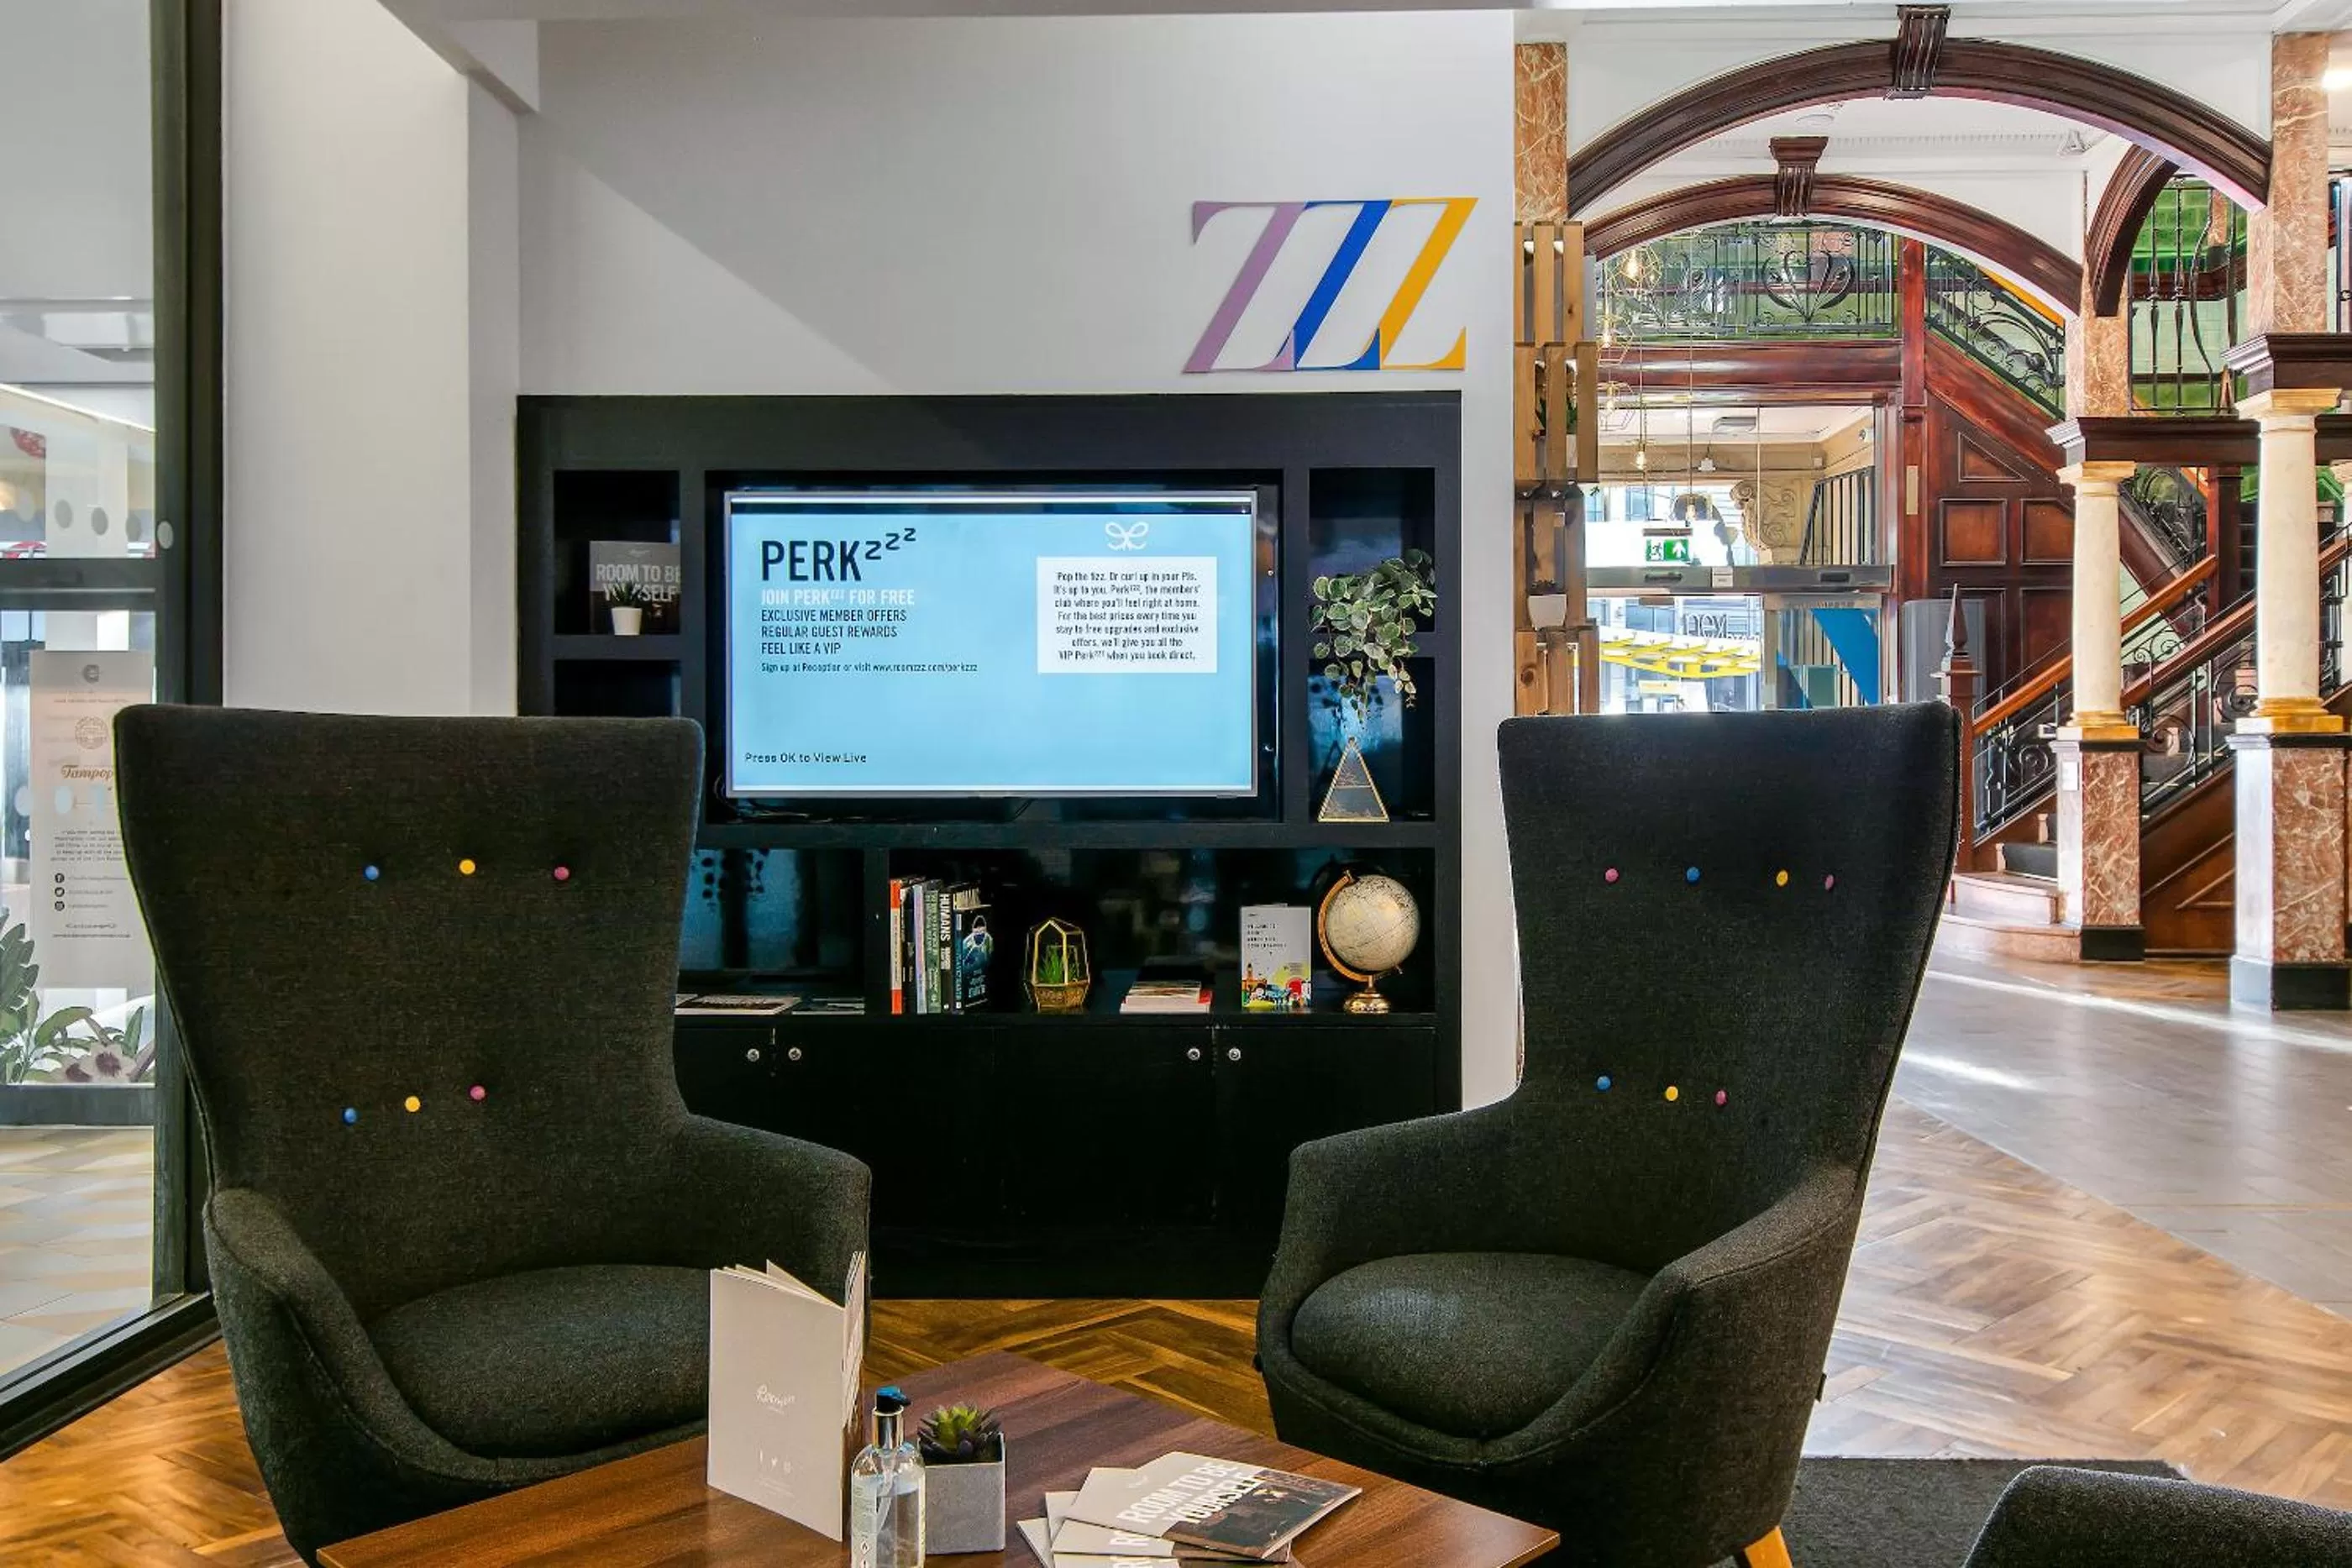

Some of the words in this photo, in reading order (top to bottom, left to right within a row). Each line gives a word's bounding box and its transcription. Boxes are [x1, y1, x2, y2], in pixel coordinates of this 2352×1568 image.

[596, 564, 640, 582] ROOM
[642, 564, 661, 582] TO
[1058, 572, 1073, 583] Pop
[1075, 572, 1088, 581] the
[1121, 572, 1137, 581] curl
[1140, 572, 1148, 583] up
[1152, 572, 1159, 581] in
[1162, 572, 1179, 583] your
[602, 583, 680, 602] YSELF
[1069, 585, 1077, 596] up
[1081, 585, 1089, 594] to
[1146, 585, 1158, 594] the
[762, 589, 790, 605] JOIN
[850, 589, 875, 605] FOR
[881, 589, 915, 605] FREE
[1055, 598, 1071, 607] club
[1074, 598, 1099, 607] where
[1126, 598, 1141, 607] feel
[1143, 598, 1162, 609] right
[1164, 598, 1172, 607] at
[762, 610, 816, 621] EXCLUSIVE
[820, 610, 864, 621] MEMBER
[867, 610, 906, 621] OFFERS
[1058, 611, 1071, 620] For
[1074, 611, 1087, 620] the
[1089, 611, 1105, 620] best
[1162, 611, 1179, 620] time
[1182, 611, 1197, 621] you
[762, 626, 808, 637] REGULAR
[811, 626, 844, 637] GUEST
[848, 626, 898, 637] REWARDS
[1075, 624, 1083, 633] to
[1085, 624, 1101, 633] free
[1144, 624, 1159, 633] and
[1162, 624, 1199, 633] exclusive
[762, 642, 786, 654] FEEL
[790, 642, 811, 654] LIKE
[813, 642, 821, 654] A
[823, 642, 841, 654] VIP
[1122, 637, 1138, 648] give
[1141, 637, 1155, 648] you
[1158, 637, 1167, 647] all
[1169, 637, 1183, 647] the
[1058, 650, 1073, 659] VIP
[1107, 650, 1128, 659] when
[1131, 650, 1145, 662] you
[1147, 650, 1166, 659] book
[762, 663, 779, 673] Sign
[780, 664, 790, 673] up
[802, 663, 841, 673] Reception
[854, 663, 871, 671] visit
[745, 753, 777, 763] Press
[780, 753, 796, 763] OK
[799, 753, 811, 763] to
[813, 753, 840, 763] View
[843, 753, 867, 763] Live
[60, 764, 113, 781] Tampop
[940, 894, 951, 941] HUMANS
[1116, 1488, 1193, 1524] ROOM
[1167, 1474, 1211, 1491] TO
[1162, 1471, 1267, 1525] YOURSELF
